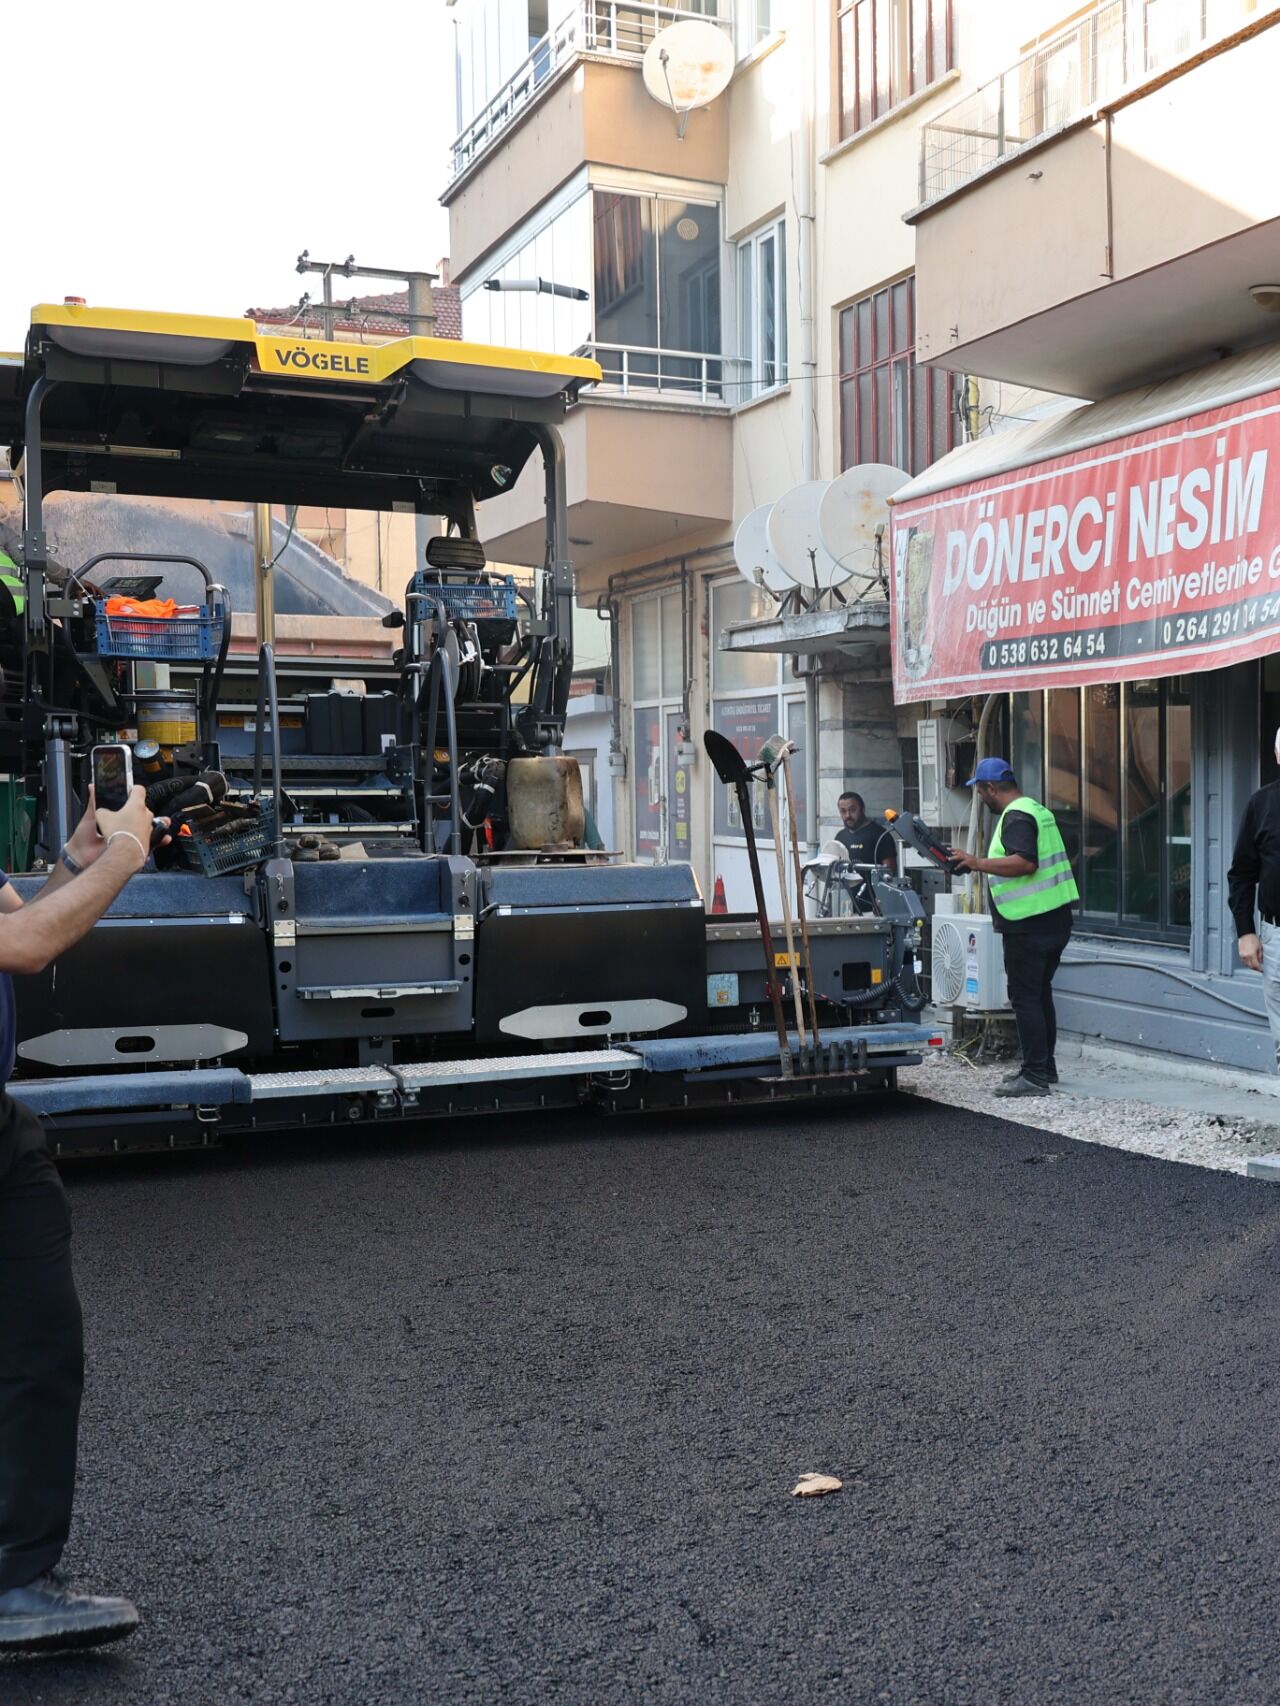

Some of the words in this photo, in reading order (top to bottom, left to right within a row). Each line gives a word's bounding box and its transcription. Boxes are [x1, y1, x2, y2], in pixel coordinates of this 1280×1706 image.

[275, 347, 369, 374] VÖGELE
[966, 597, 1022, 638] Düğün
[1027, 599, 1046, 625] ve
[1051, 580, 1121, 621] Sünnet
[1126, 555, 1263, 610] Cemiyetlerine
[989, 645, 998, 666] 0
[1001, 642, 1026, 665] 538
[1030, 638, 1058, 662] 632
[1063, 635, 1082, 658] 64
[1086, 632, 1106, 655] 54
[1163, 621, 1172, 644] 0
[1176, 615, 1208, 643] 264
[1211, 608, 1240, 637] 291
